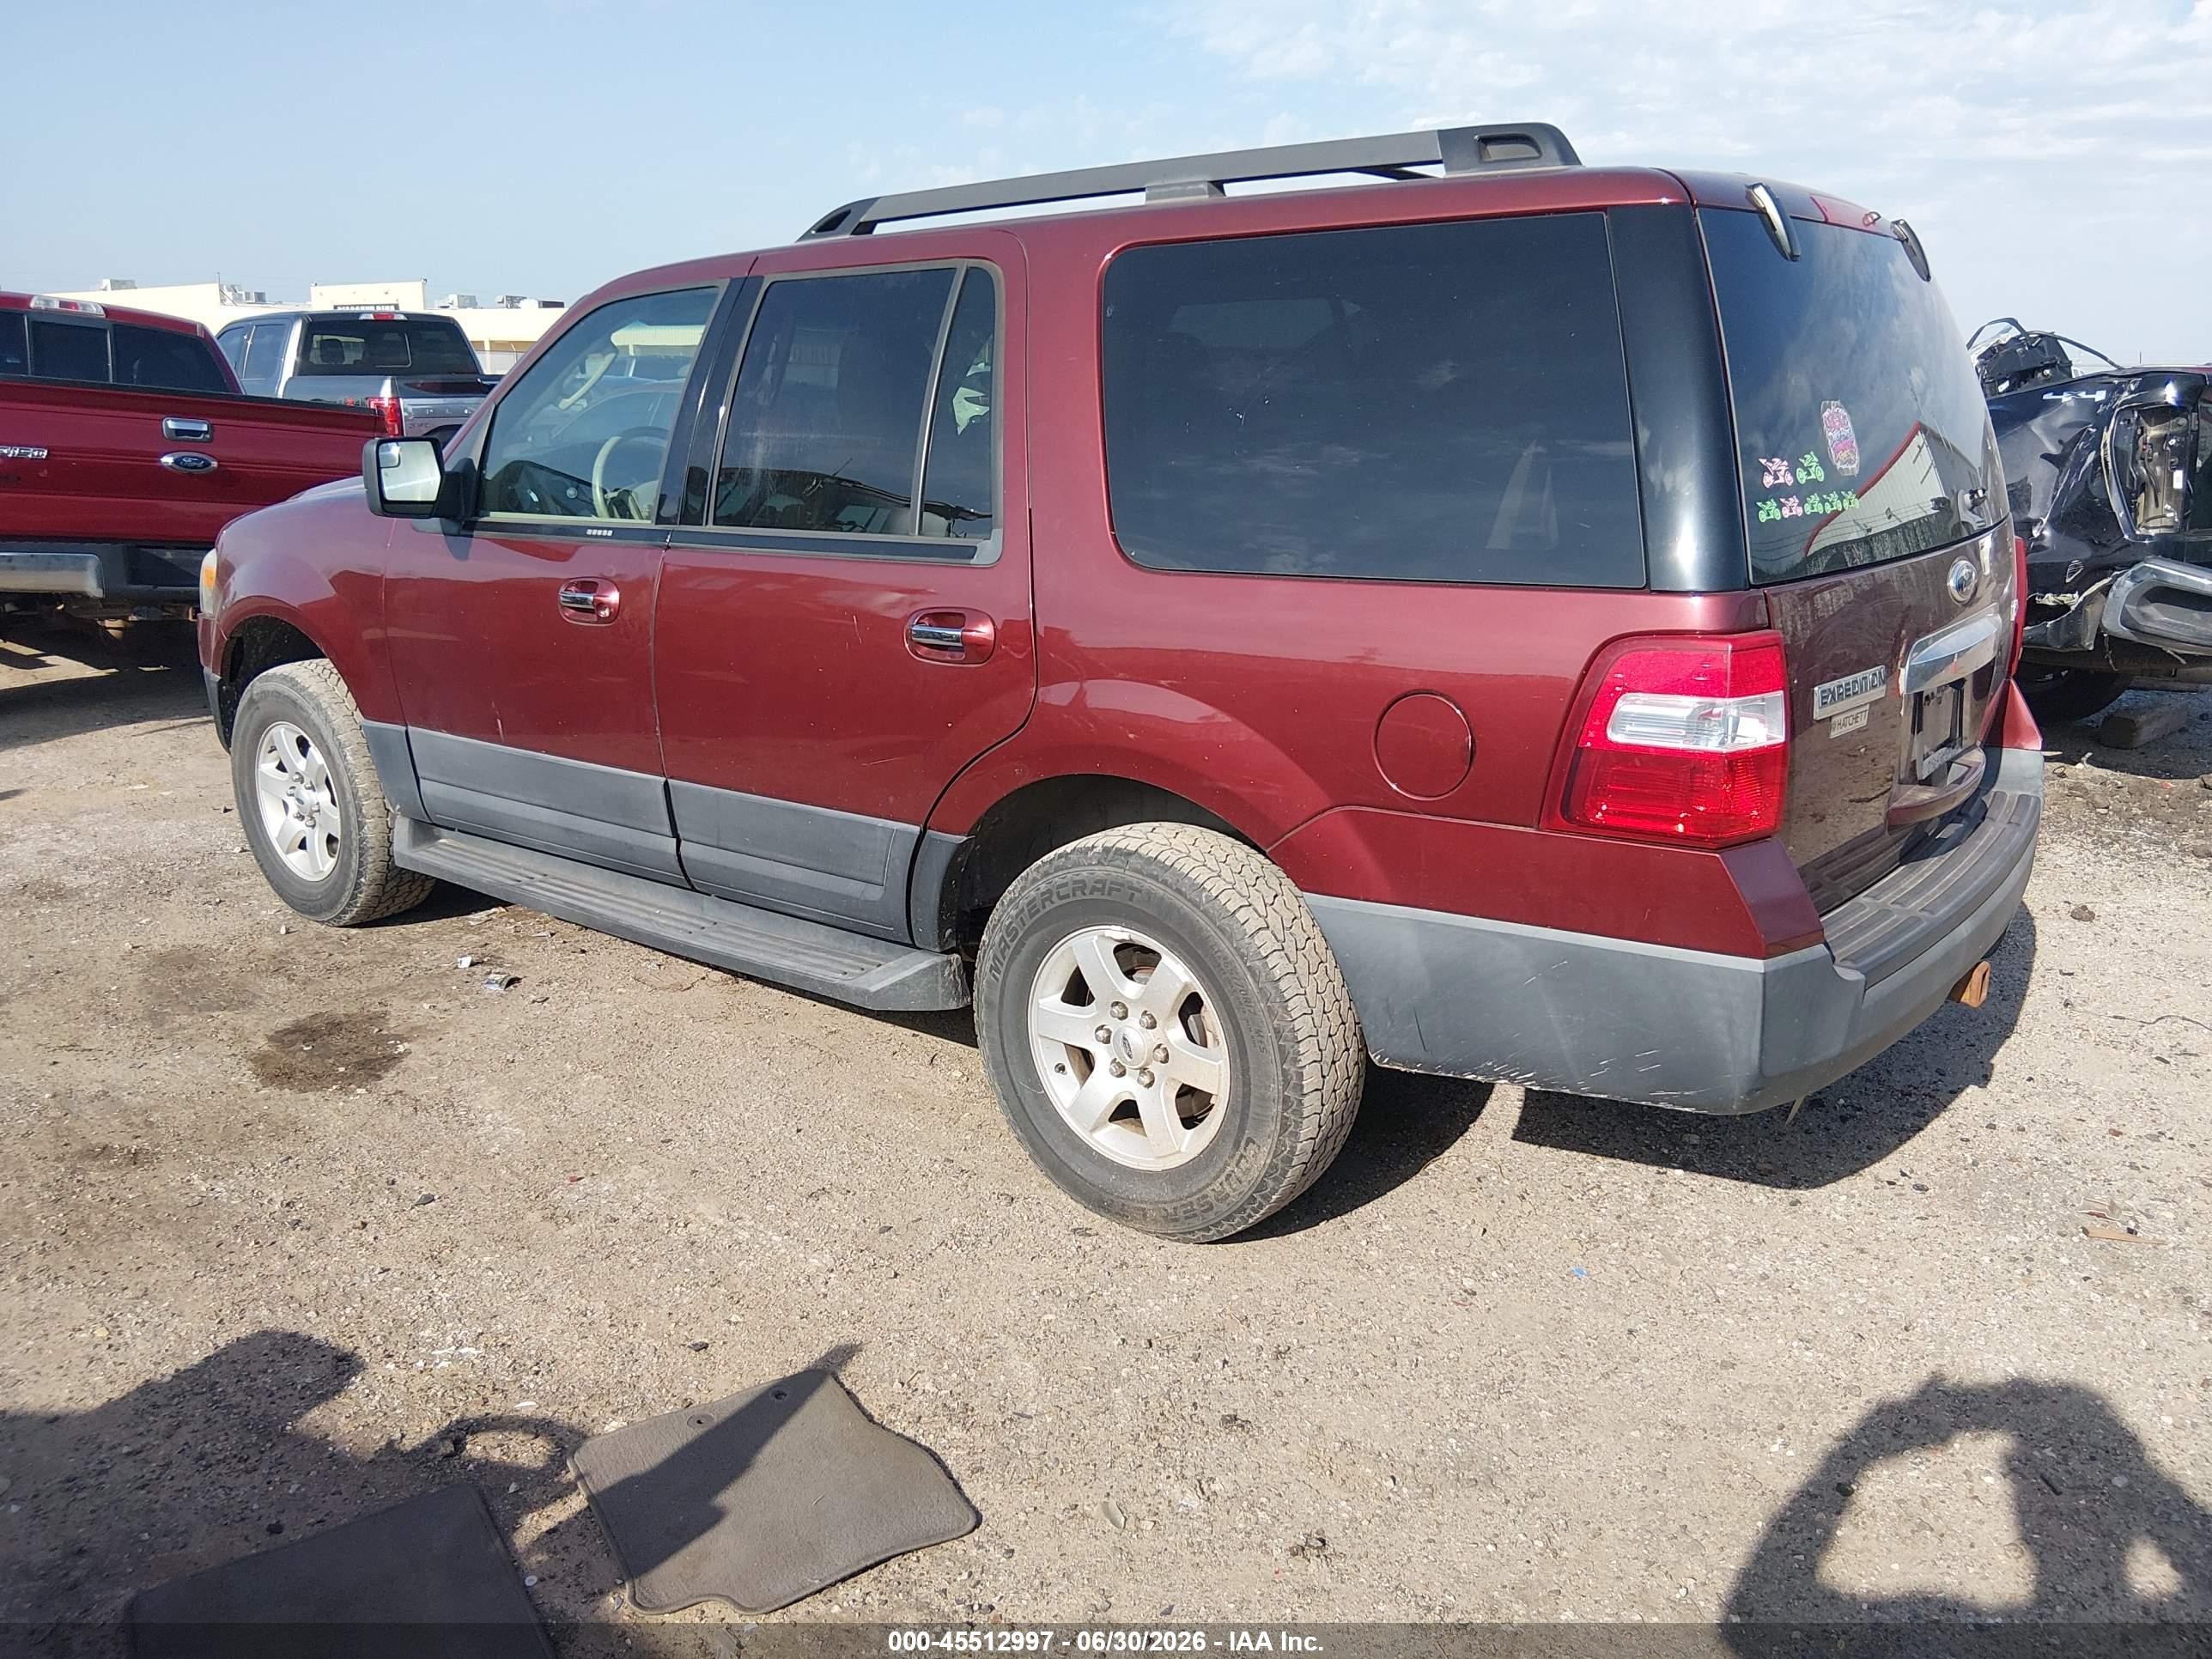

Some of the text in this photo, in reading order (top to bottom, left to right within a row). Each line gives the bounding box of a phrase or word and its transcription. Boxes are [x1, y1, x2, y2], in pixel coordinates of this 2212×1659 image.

[1818, 667, 1886, 709] EXPEDITION
[1837, 709, 1869, 730] HATCHETT
[988, 878, 1143, 983] MASTERCRAFT
